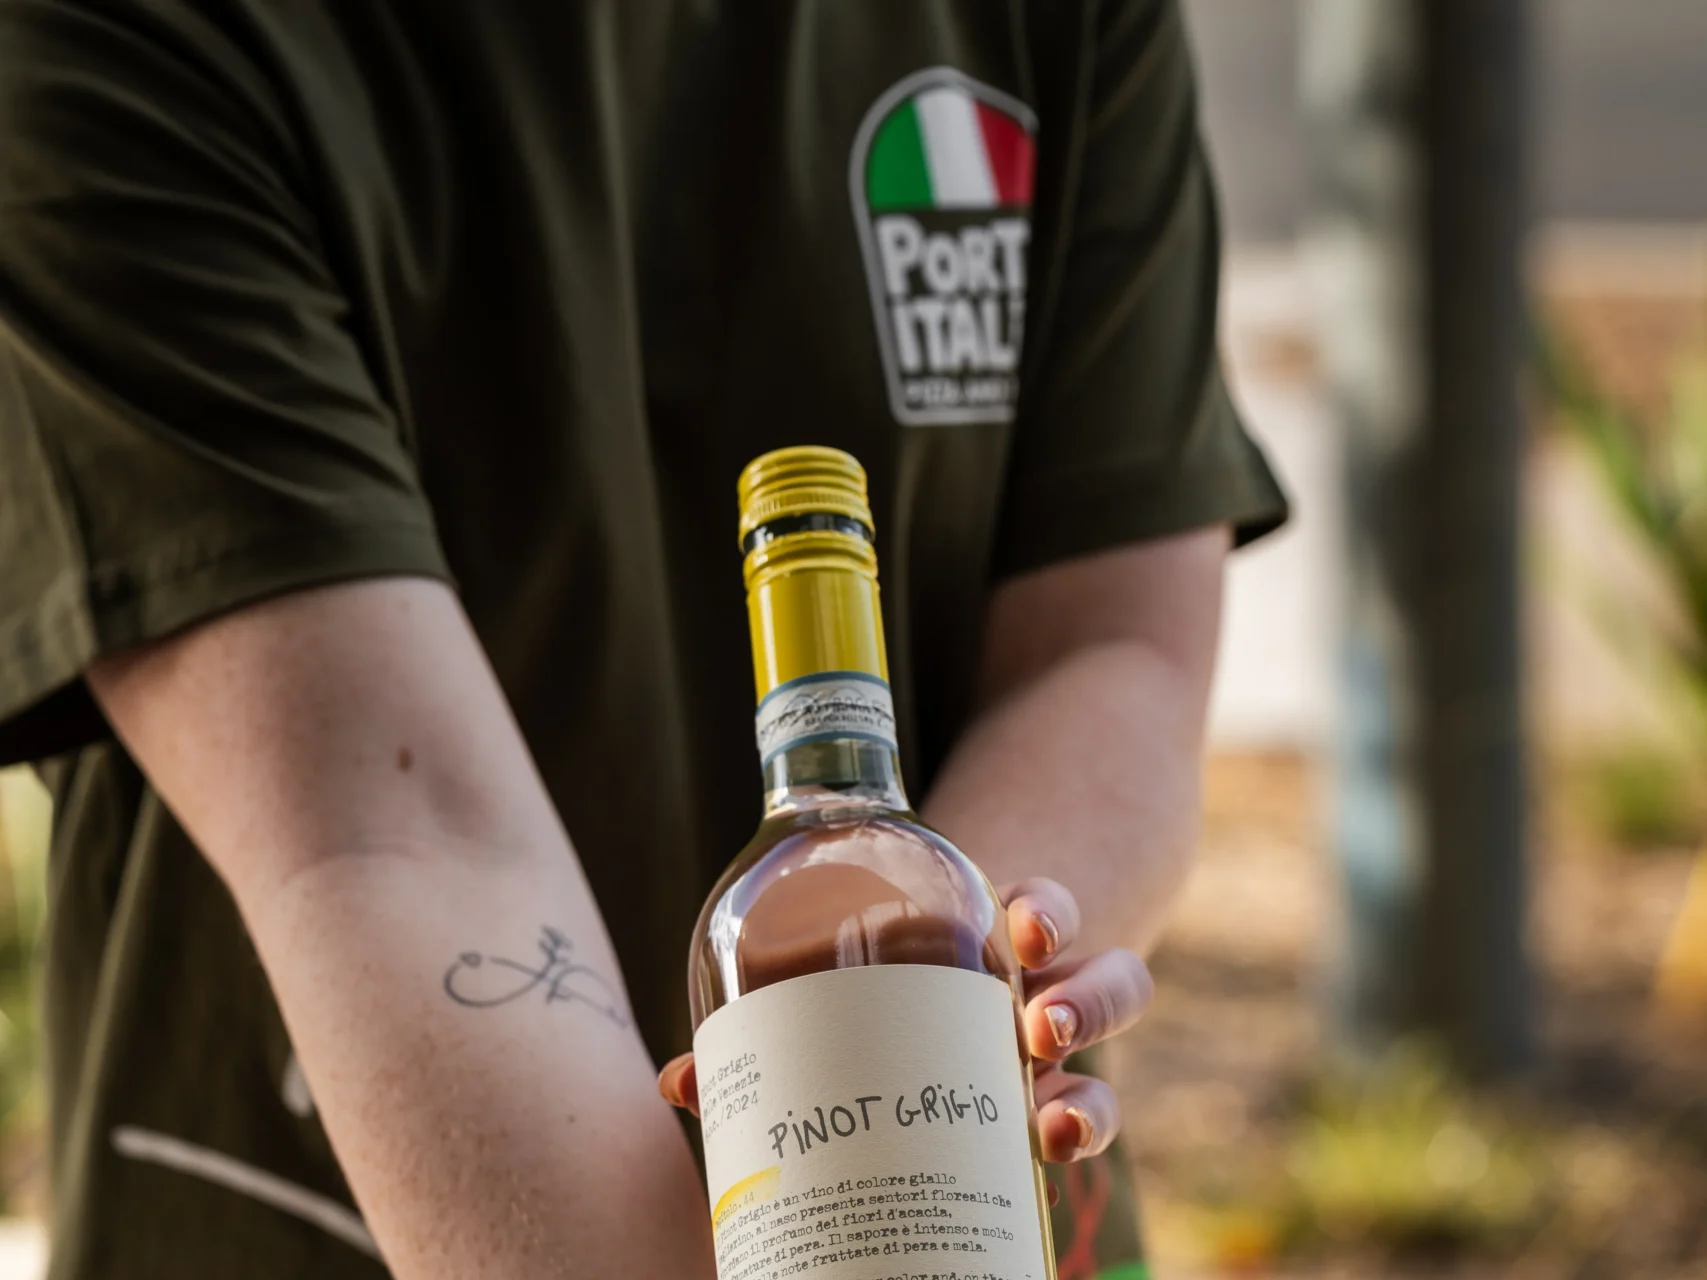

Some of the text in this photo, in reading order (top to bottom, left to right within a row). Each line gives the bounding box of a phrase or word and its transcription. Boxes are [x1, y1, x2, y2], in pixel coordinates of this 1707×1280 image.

[717, 1053, 757, 1082] Grigio
[717, 1071, 761, 1101] Venezie
[738, 1204, 772, 1227] Grigio
[783, 1194, 800, 1207] un
[802, 1186, 834, 1200] vino
[837, 1179, 854, 1194] di
[856, 1176, 906, 1190] colore
[909, 1172, 957, 1187] giallo
[756, 1222, 769, 1236] al
[770, 1213, 797, 1230] naso
[799, 1196, 865, 1222] presenta
[868, 1188, 928, 1204] sentori
[931, 1189, 990, 1204] floreali
[992, 1194, 1012, 1208] che
[750, 1242, 762, 1257] il
[762, 1225, 812, 1253] profumo
[815, 1216, 839, 1233] dei
[842, 1209, 884, 1226] fiori
[887, 1206, 952, 1221] d'acacia,
[774, 1249, 787, 1264] di
[789, 1240, 825, 1258] pera.
[828, 1233, 844, 1246] Il
[847, 1227, 898, 1242] sapore
[901, 1223, 910, 1236] è
[914, 1223, 969, 1235] intenso
[971, 1226, 979, 1235] e
[982, 1227, 1014, 1241] molto
[781, 1260, 809, 1278] note
[812, 1245, 879, 1268] fruttate
[883, 1241, 900, 1256] di
[902, 1242, 938, 1254] pera
[941, 1242, 949, 1251] e
[953, 1241, 987, 1252] mela.
